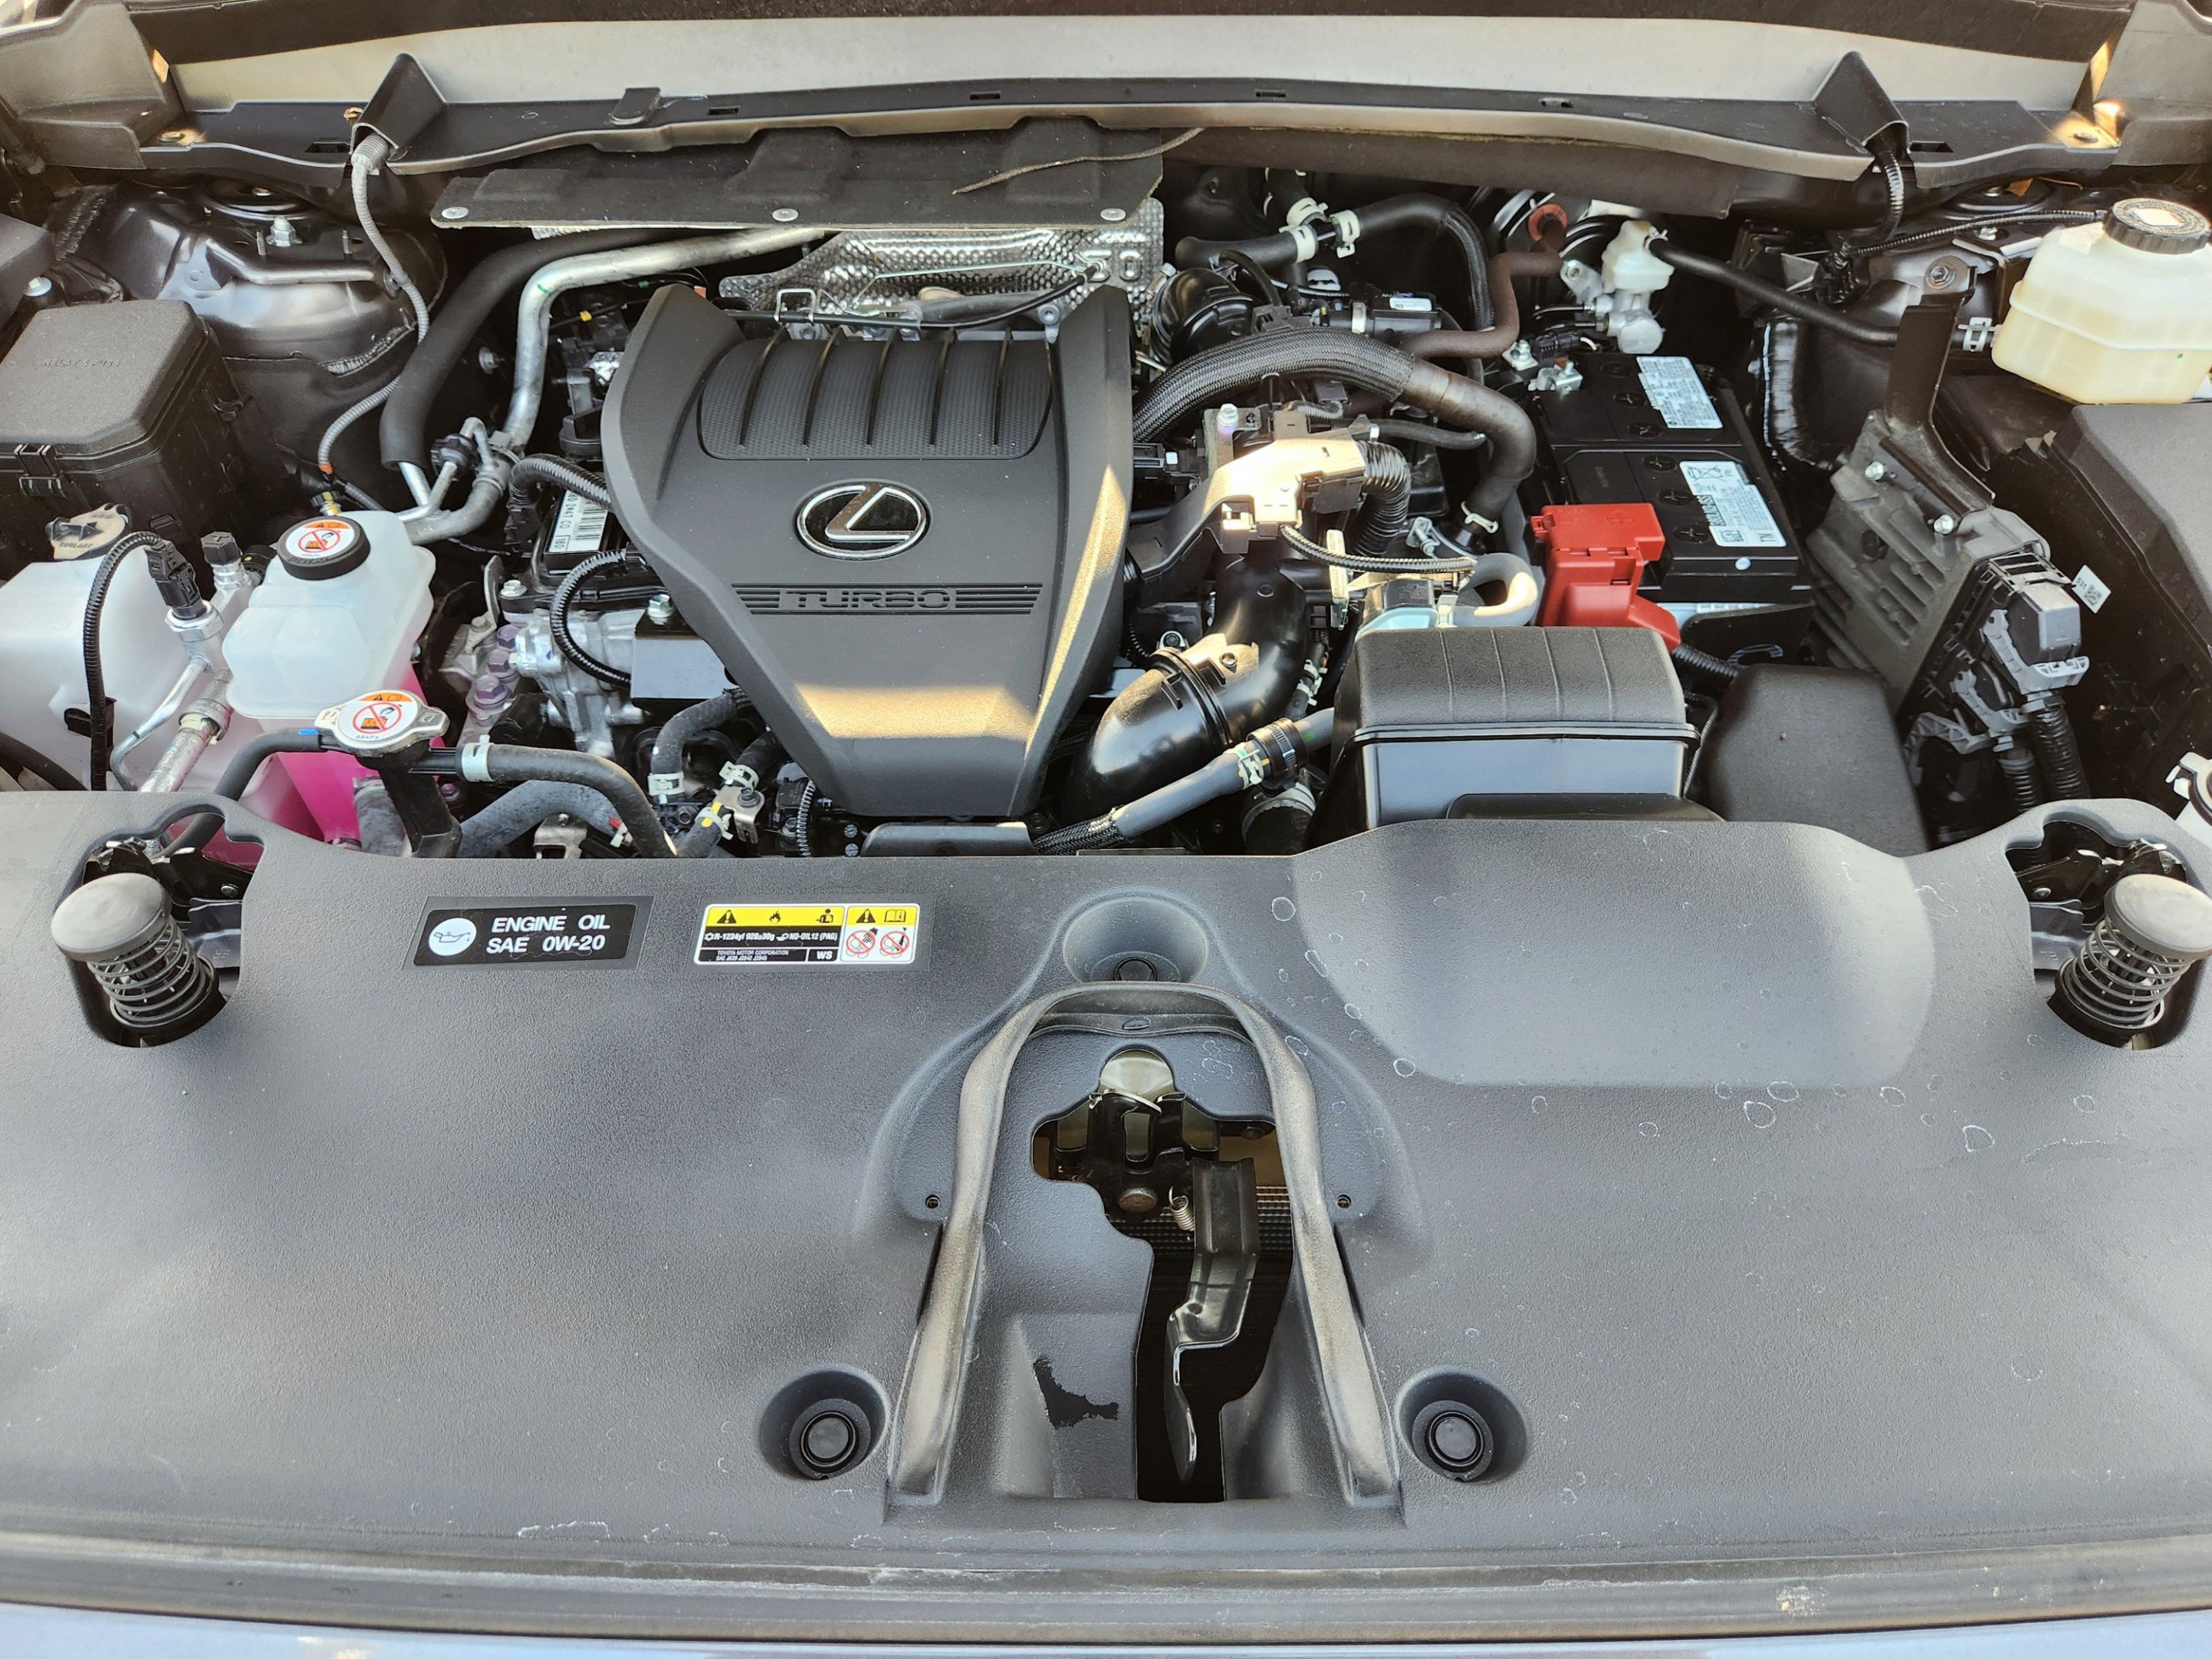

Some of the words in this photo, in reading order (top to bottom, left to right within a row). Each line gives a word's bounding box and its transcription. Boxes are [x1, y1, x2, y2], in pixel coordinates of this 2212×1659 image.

[783, 588, 952, 609] TURBO
[492, 916, 568, 933] ENGINE
[578, 914, 611, 930] OIL
[486, 937, 530, 954] SAE
[542, 935, 606, 952] 0W-20
[714, 932, 746, 942] R-1234yf
[819, 932, 838, 942] (PAG)
[816, 950, 833, 960] WS
